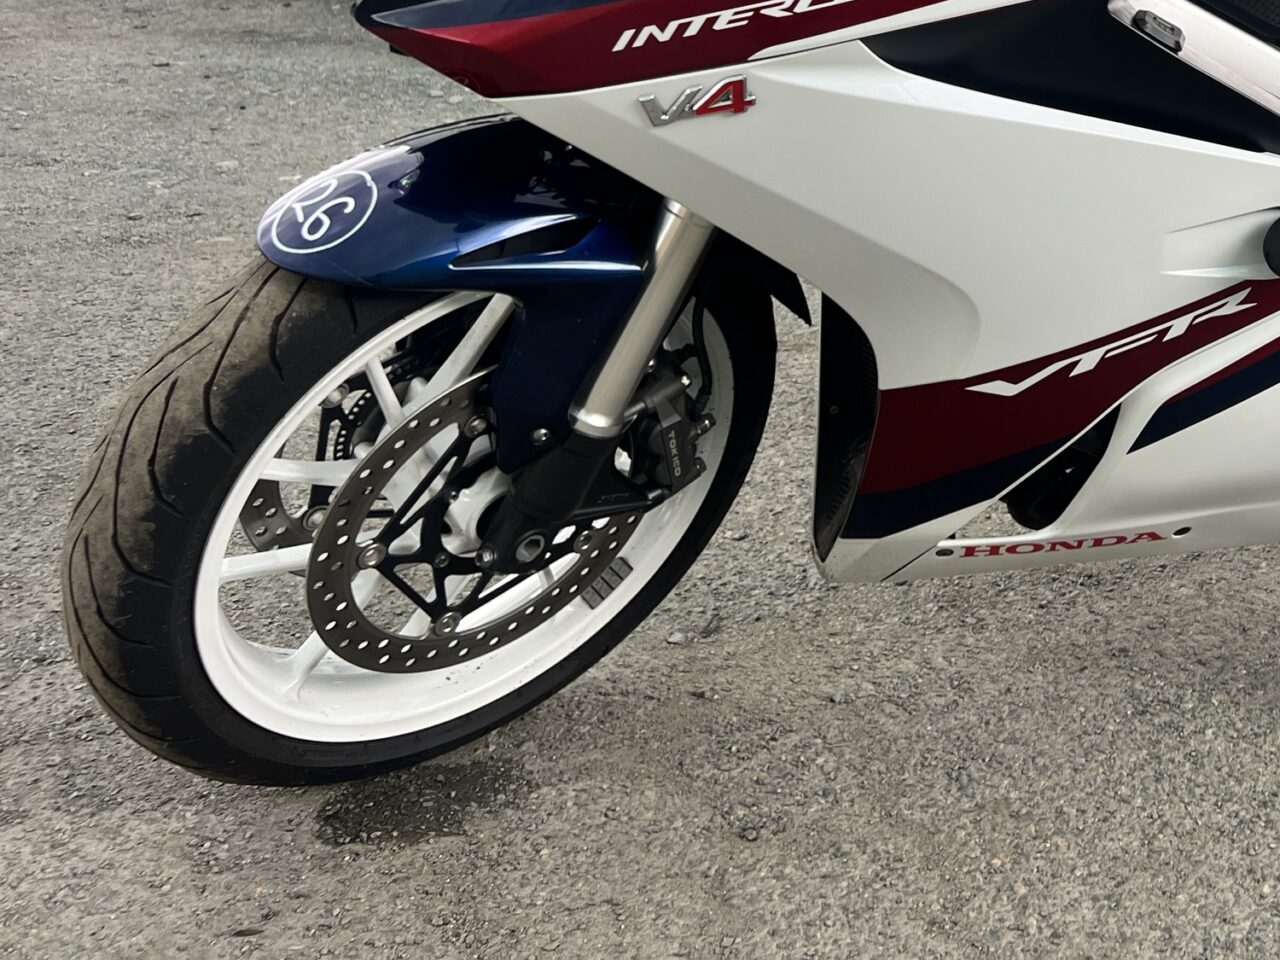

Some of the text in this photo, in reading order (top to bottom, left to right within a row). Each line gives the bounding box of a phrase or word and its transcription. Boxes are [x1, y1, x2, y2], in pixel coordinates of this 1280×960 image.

[638, 74, 757, 127] V4
[291, 178, 356, 241] 26
[965, 287, 1258, 397] VFR
[668, 430, 681, 477] TOKICO
[959, 531, 1168, 559] HONDA
